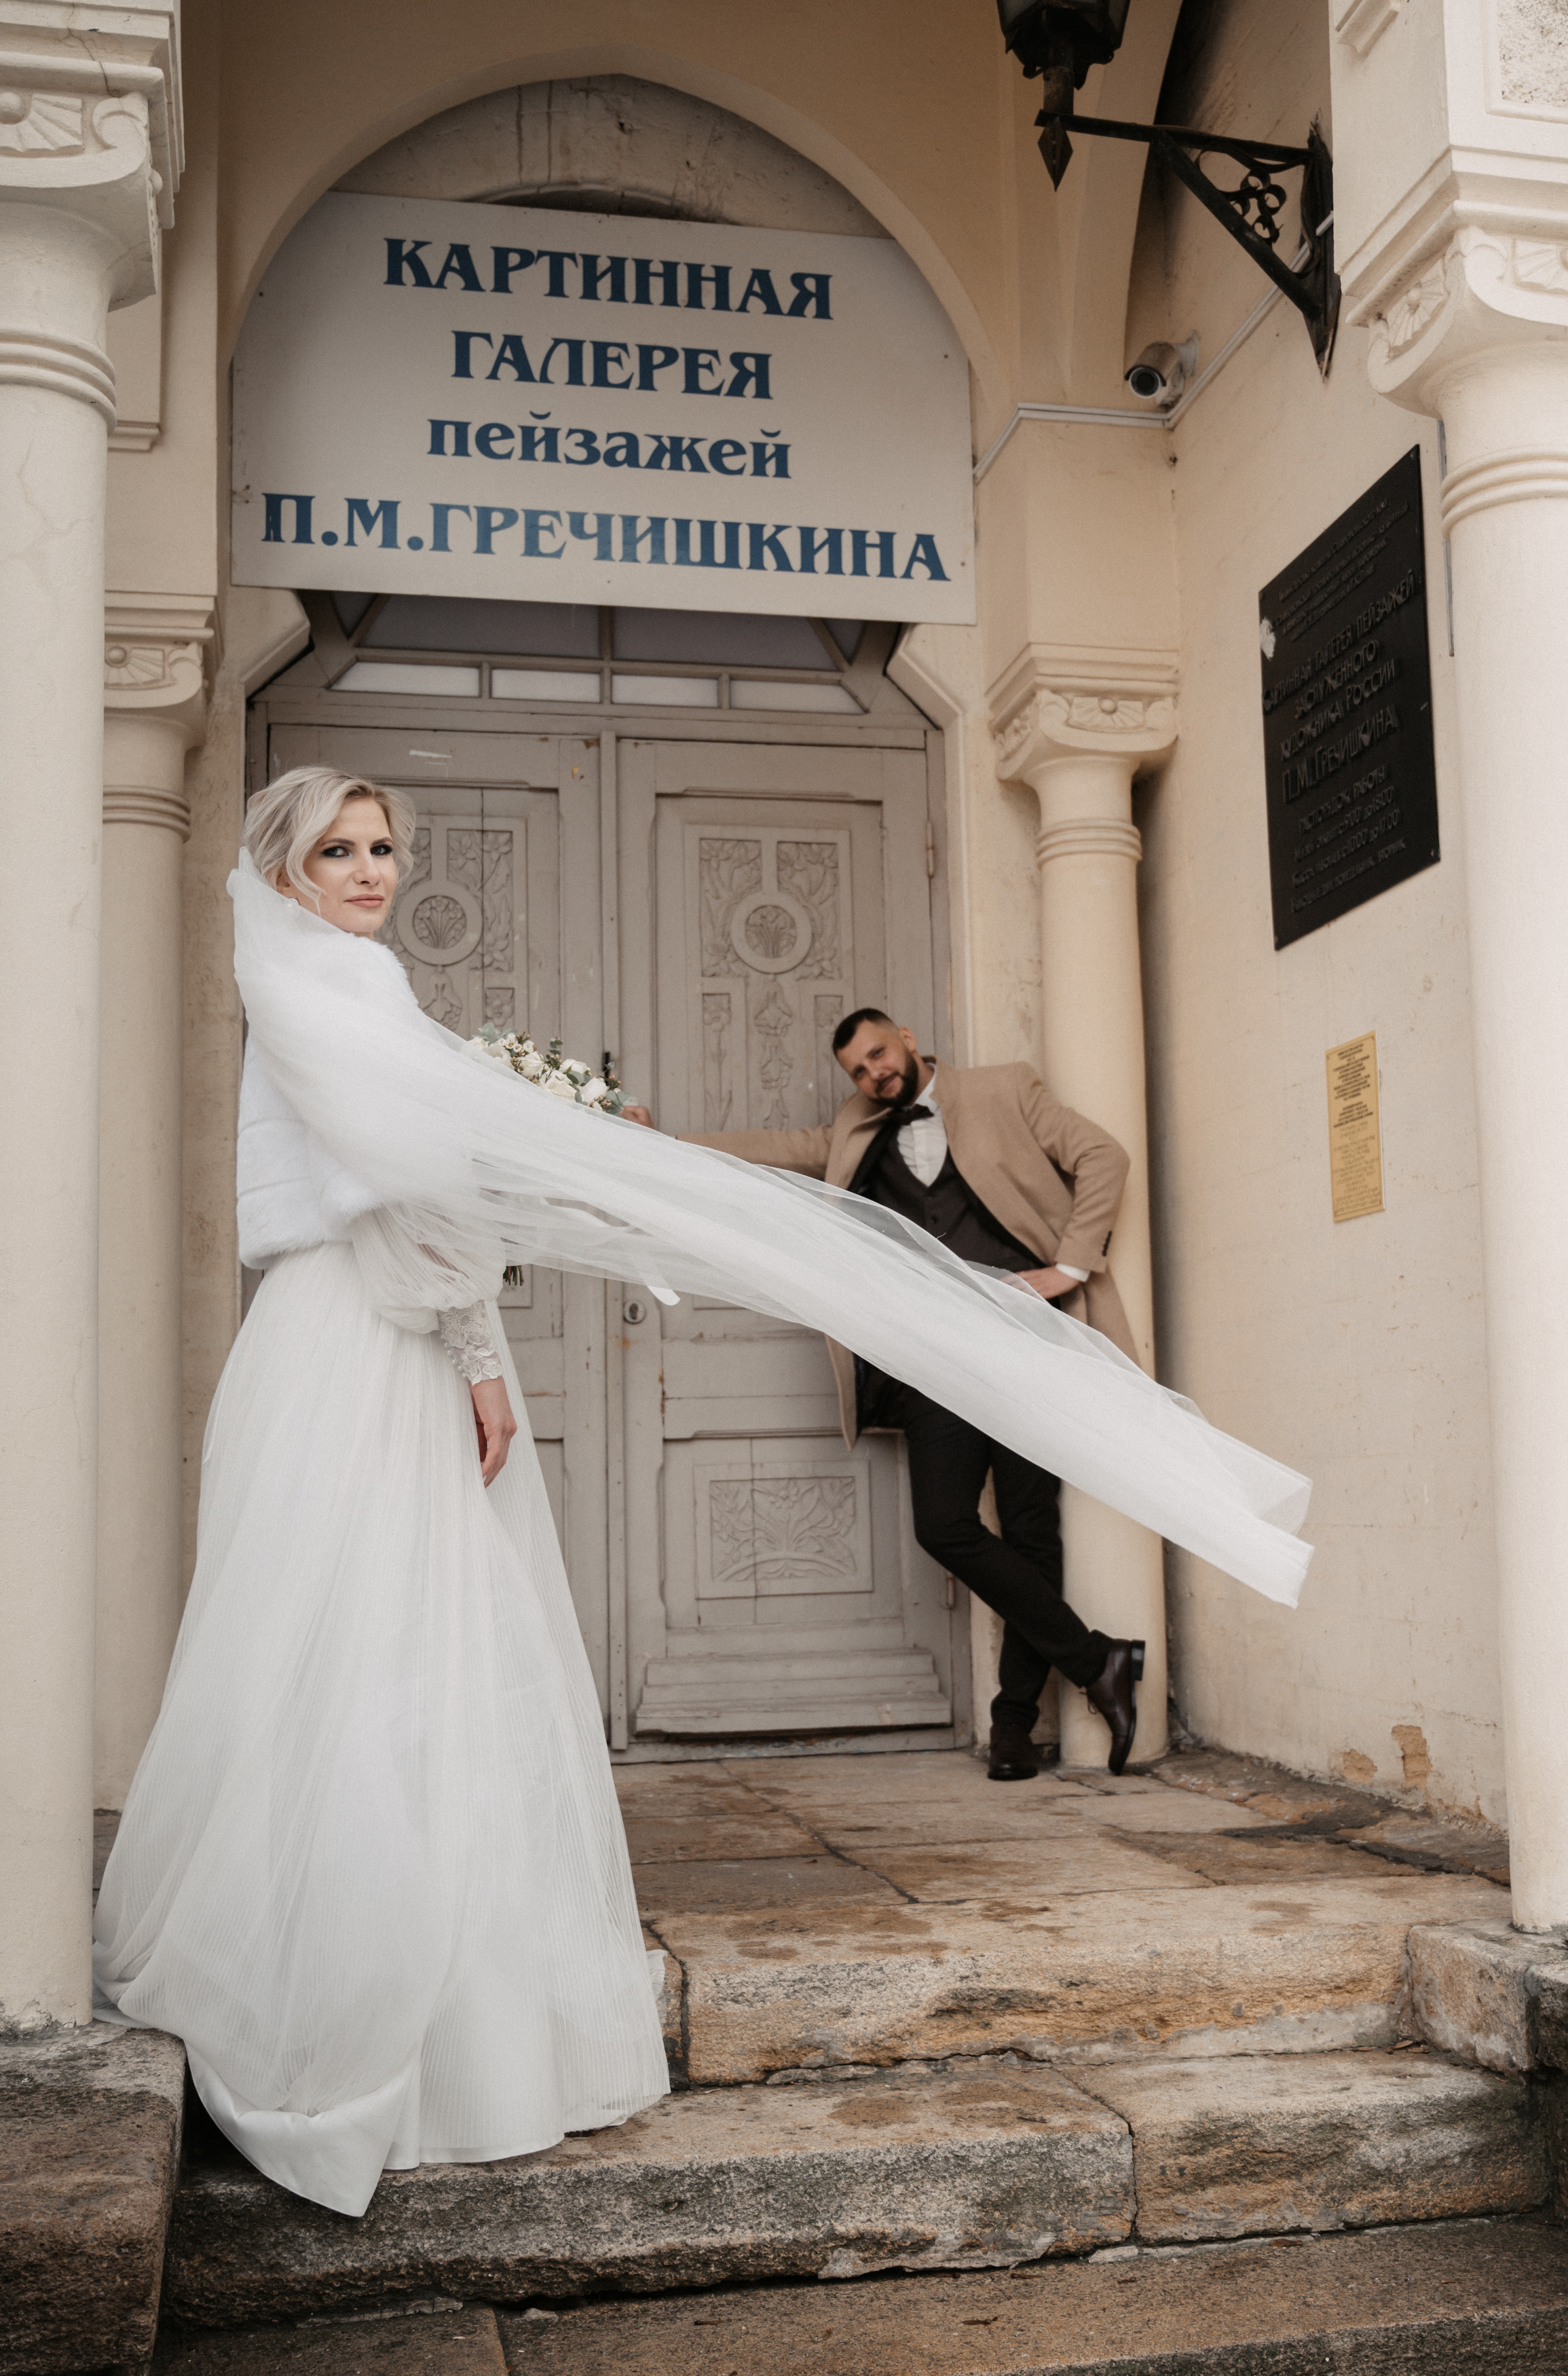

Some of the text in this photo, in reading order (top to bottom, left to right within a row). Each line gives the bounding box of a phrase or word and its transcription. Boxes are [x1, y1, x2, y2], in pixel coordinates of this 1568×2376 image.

[384, 238, 833, 320] КАРТИННАЯ
[451, 331, 773, 399] ГАЛЕРЕЯ
[427, 411, 791, 479] пейзажей
[262, 492, 951, 581] П.М.ГРЕЧИШКИНА
[1315, 626, 1351, 670] ГАЛЕРЕЯ
[1356, 570, 1413, 637] ПЕЙЗАЖЕЙ
[1294, 639, 1376, 721] ЗАСЛУЖЕННОГО
